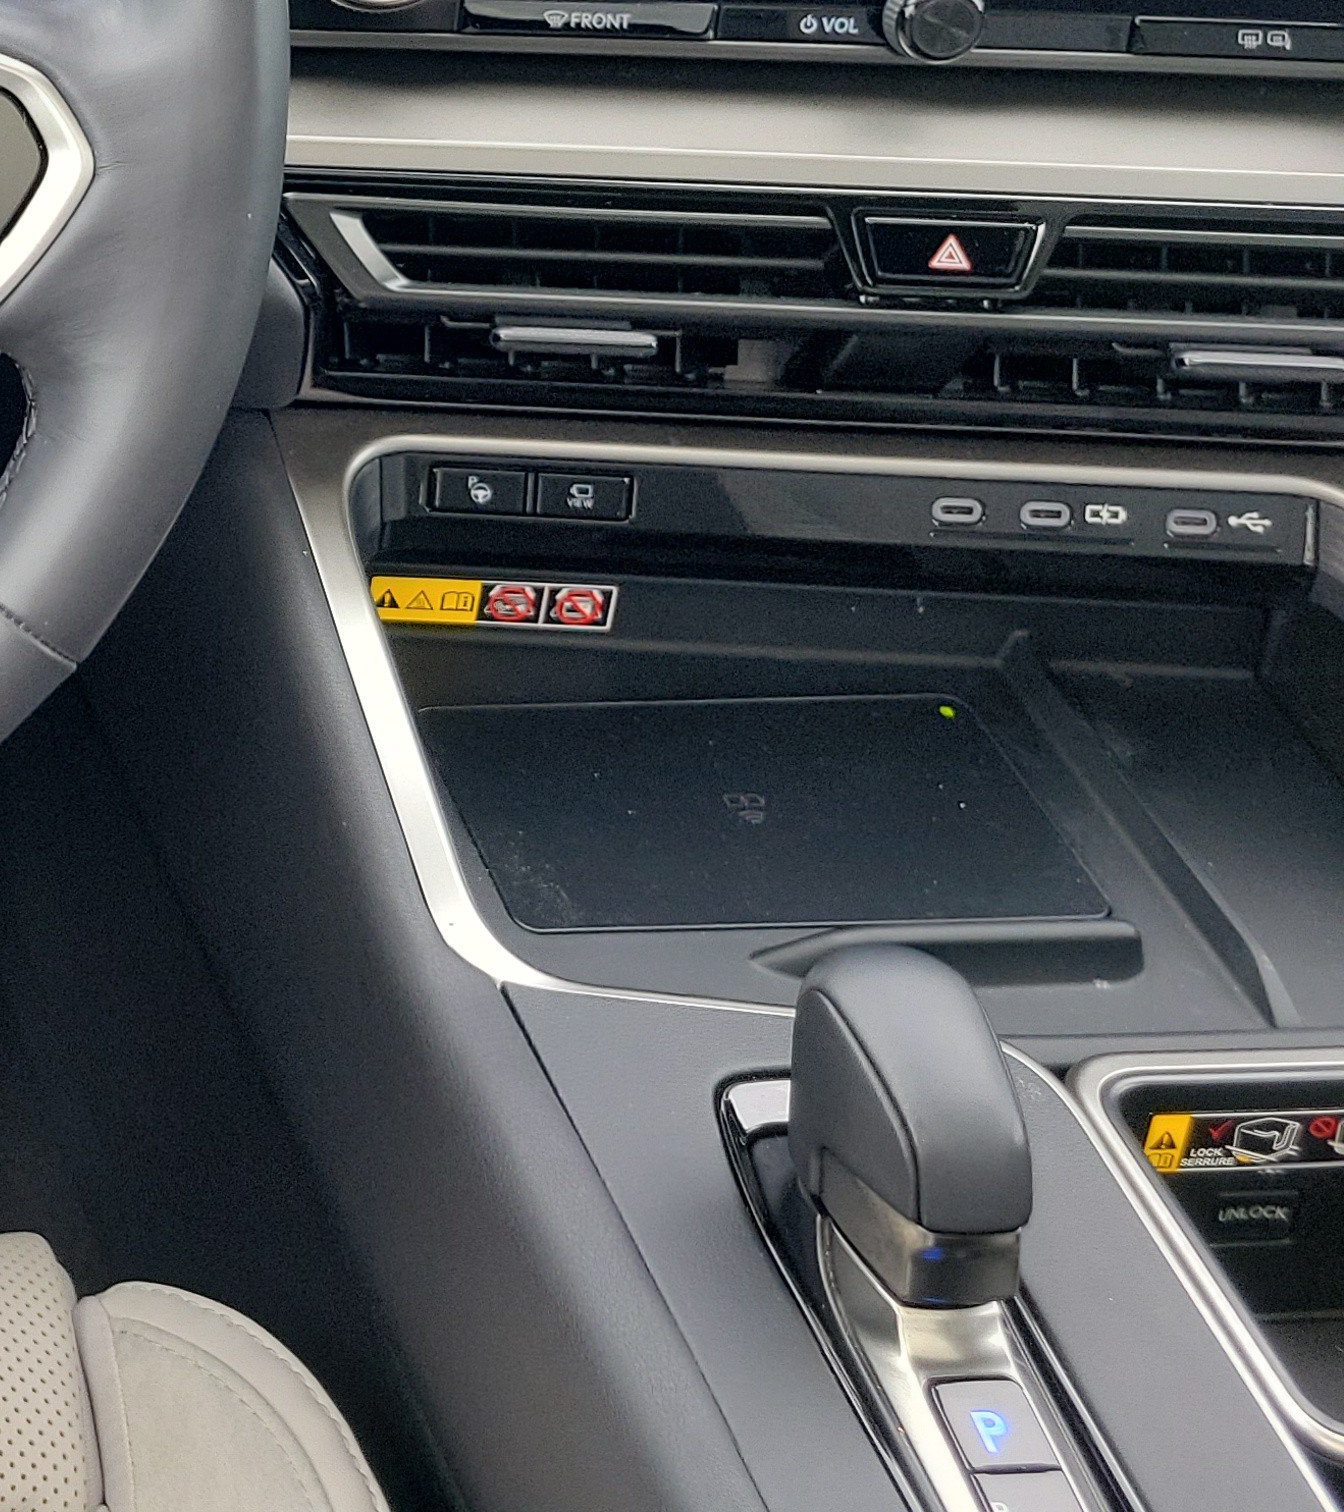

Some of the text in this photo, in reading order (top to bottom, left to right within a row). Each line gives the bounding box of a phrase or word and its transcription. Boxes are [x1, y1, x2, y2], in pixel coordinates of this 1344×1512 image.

[571, 13, 632, 31] FRONT
[822, 16, 859, 35] VOL
[566, 496, 594, 510] VIEW
[1179, 1156, 1235, 1167] SERRURE
[1189, 1147, 1225, 1158] LOCK
[1218, 1205, 1290, 1223] UNLOCK
[969, 1409, 1009, 1454] P
